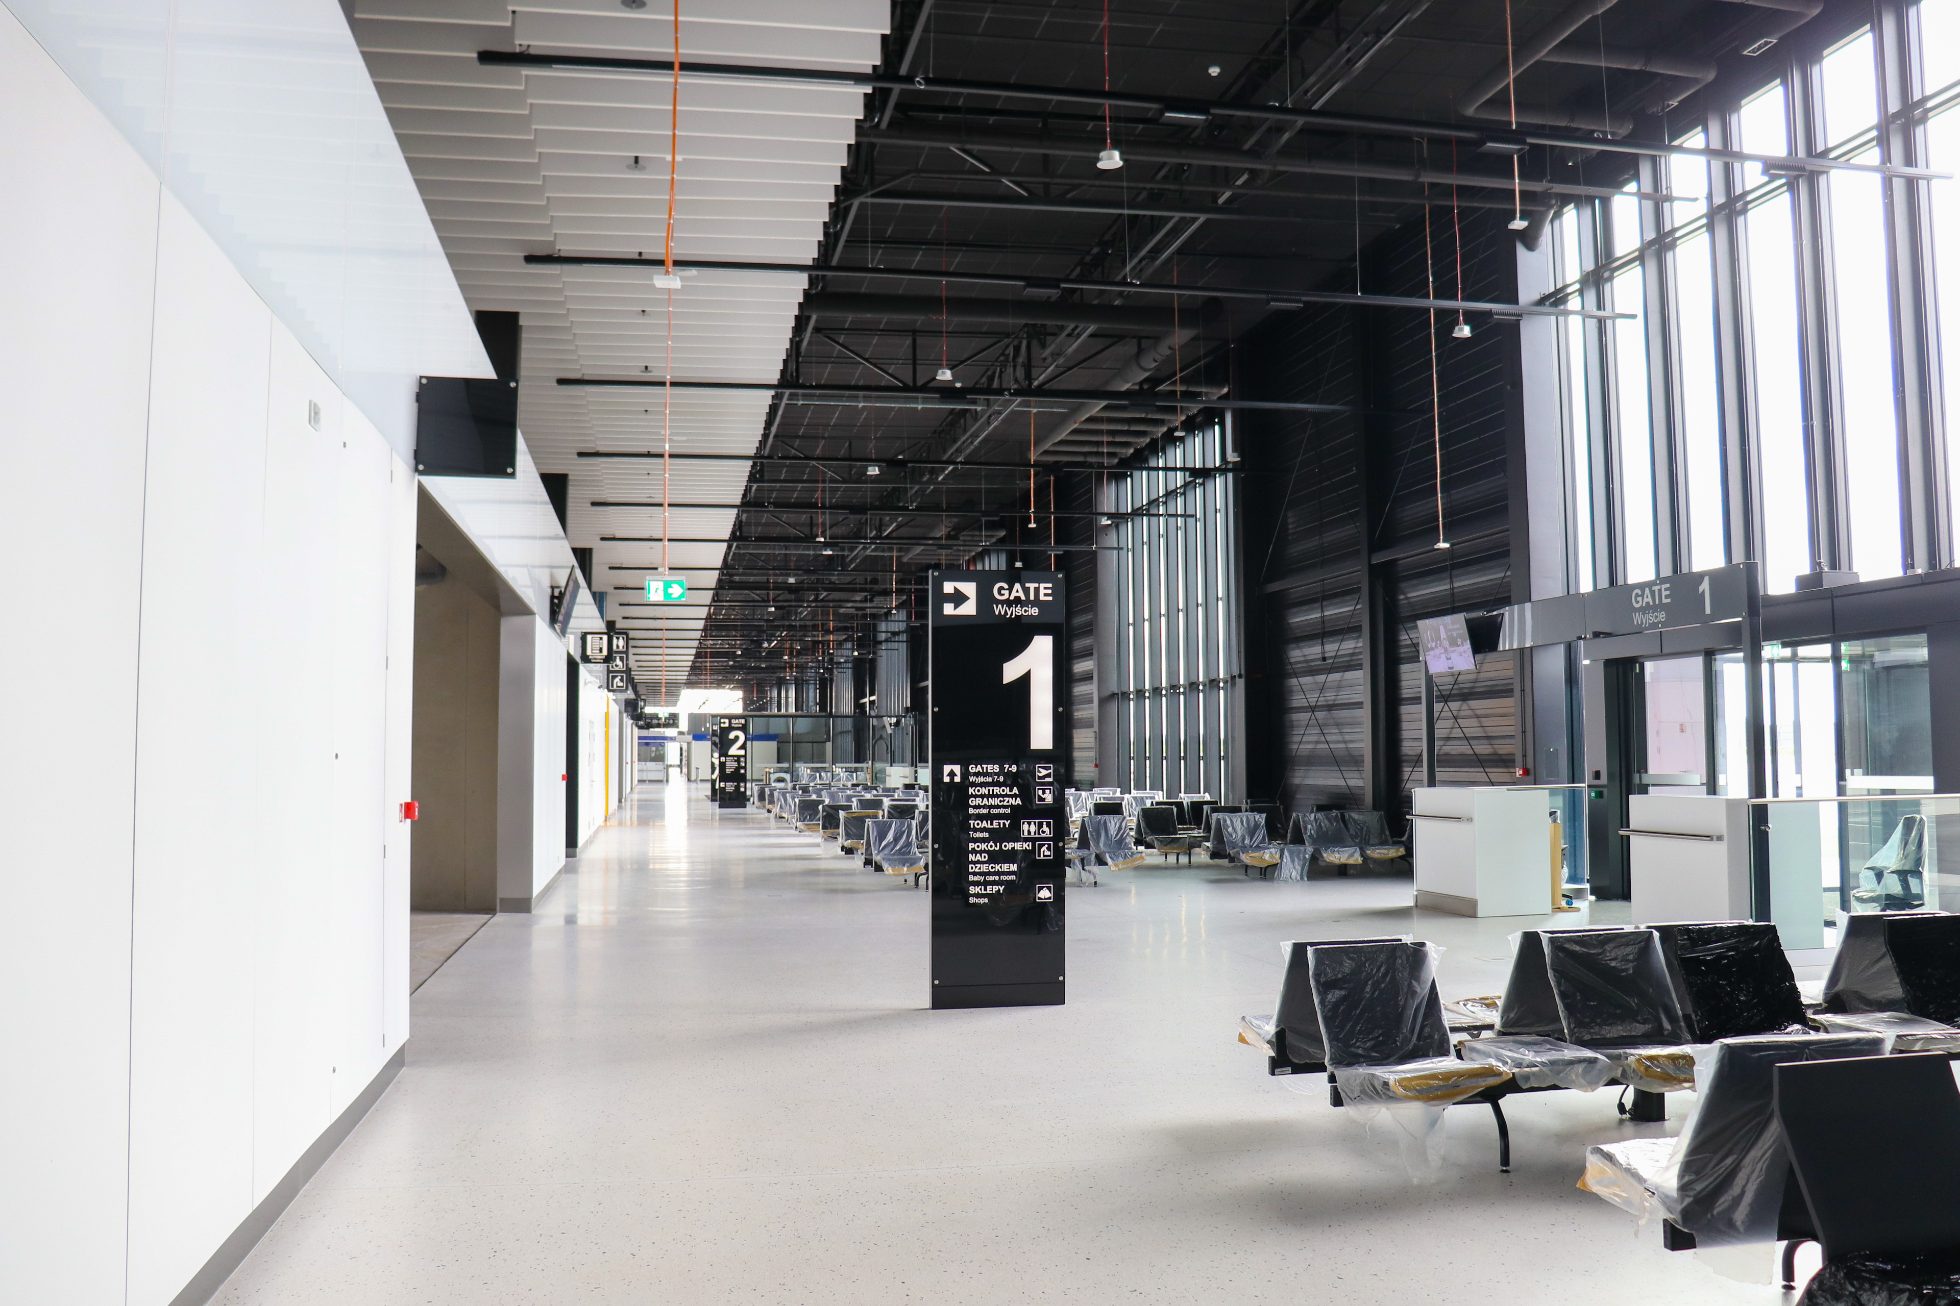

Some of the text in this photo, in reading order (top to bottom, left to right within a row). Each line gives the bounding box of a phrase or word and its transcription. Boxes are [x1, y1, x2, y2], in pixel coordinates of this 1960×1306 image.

[992, 582, 1053, 601] GATE
[1631, 575, 1711, 615] GATE 1
[993, 604, 1039, 618] Wyjście
[1632, 609, 1666, 627] Wyjście
[1002, 635, 1053, 750] 1
[728, 730, 745, 755] 2
[968, 764, 1017, 773] GATES 7-9
[968, 786, 1019, 795] KONTROLA
[968, 797, 1022, 806] GRANICZNA
[968, 820, 1011, 829] TOALETY
[968, 841, 1032, 851] POKÓJ OPIEKI
[968, 853, 988, 861] NAD
[968, 863, 1018, 872] DZIECKIEM
[968, 874, 984, 882] Baby
[968, 885, 1005, 894] SKLEPY
[968, 896, 989, 905] Shops
